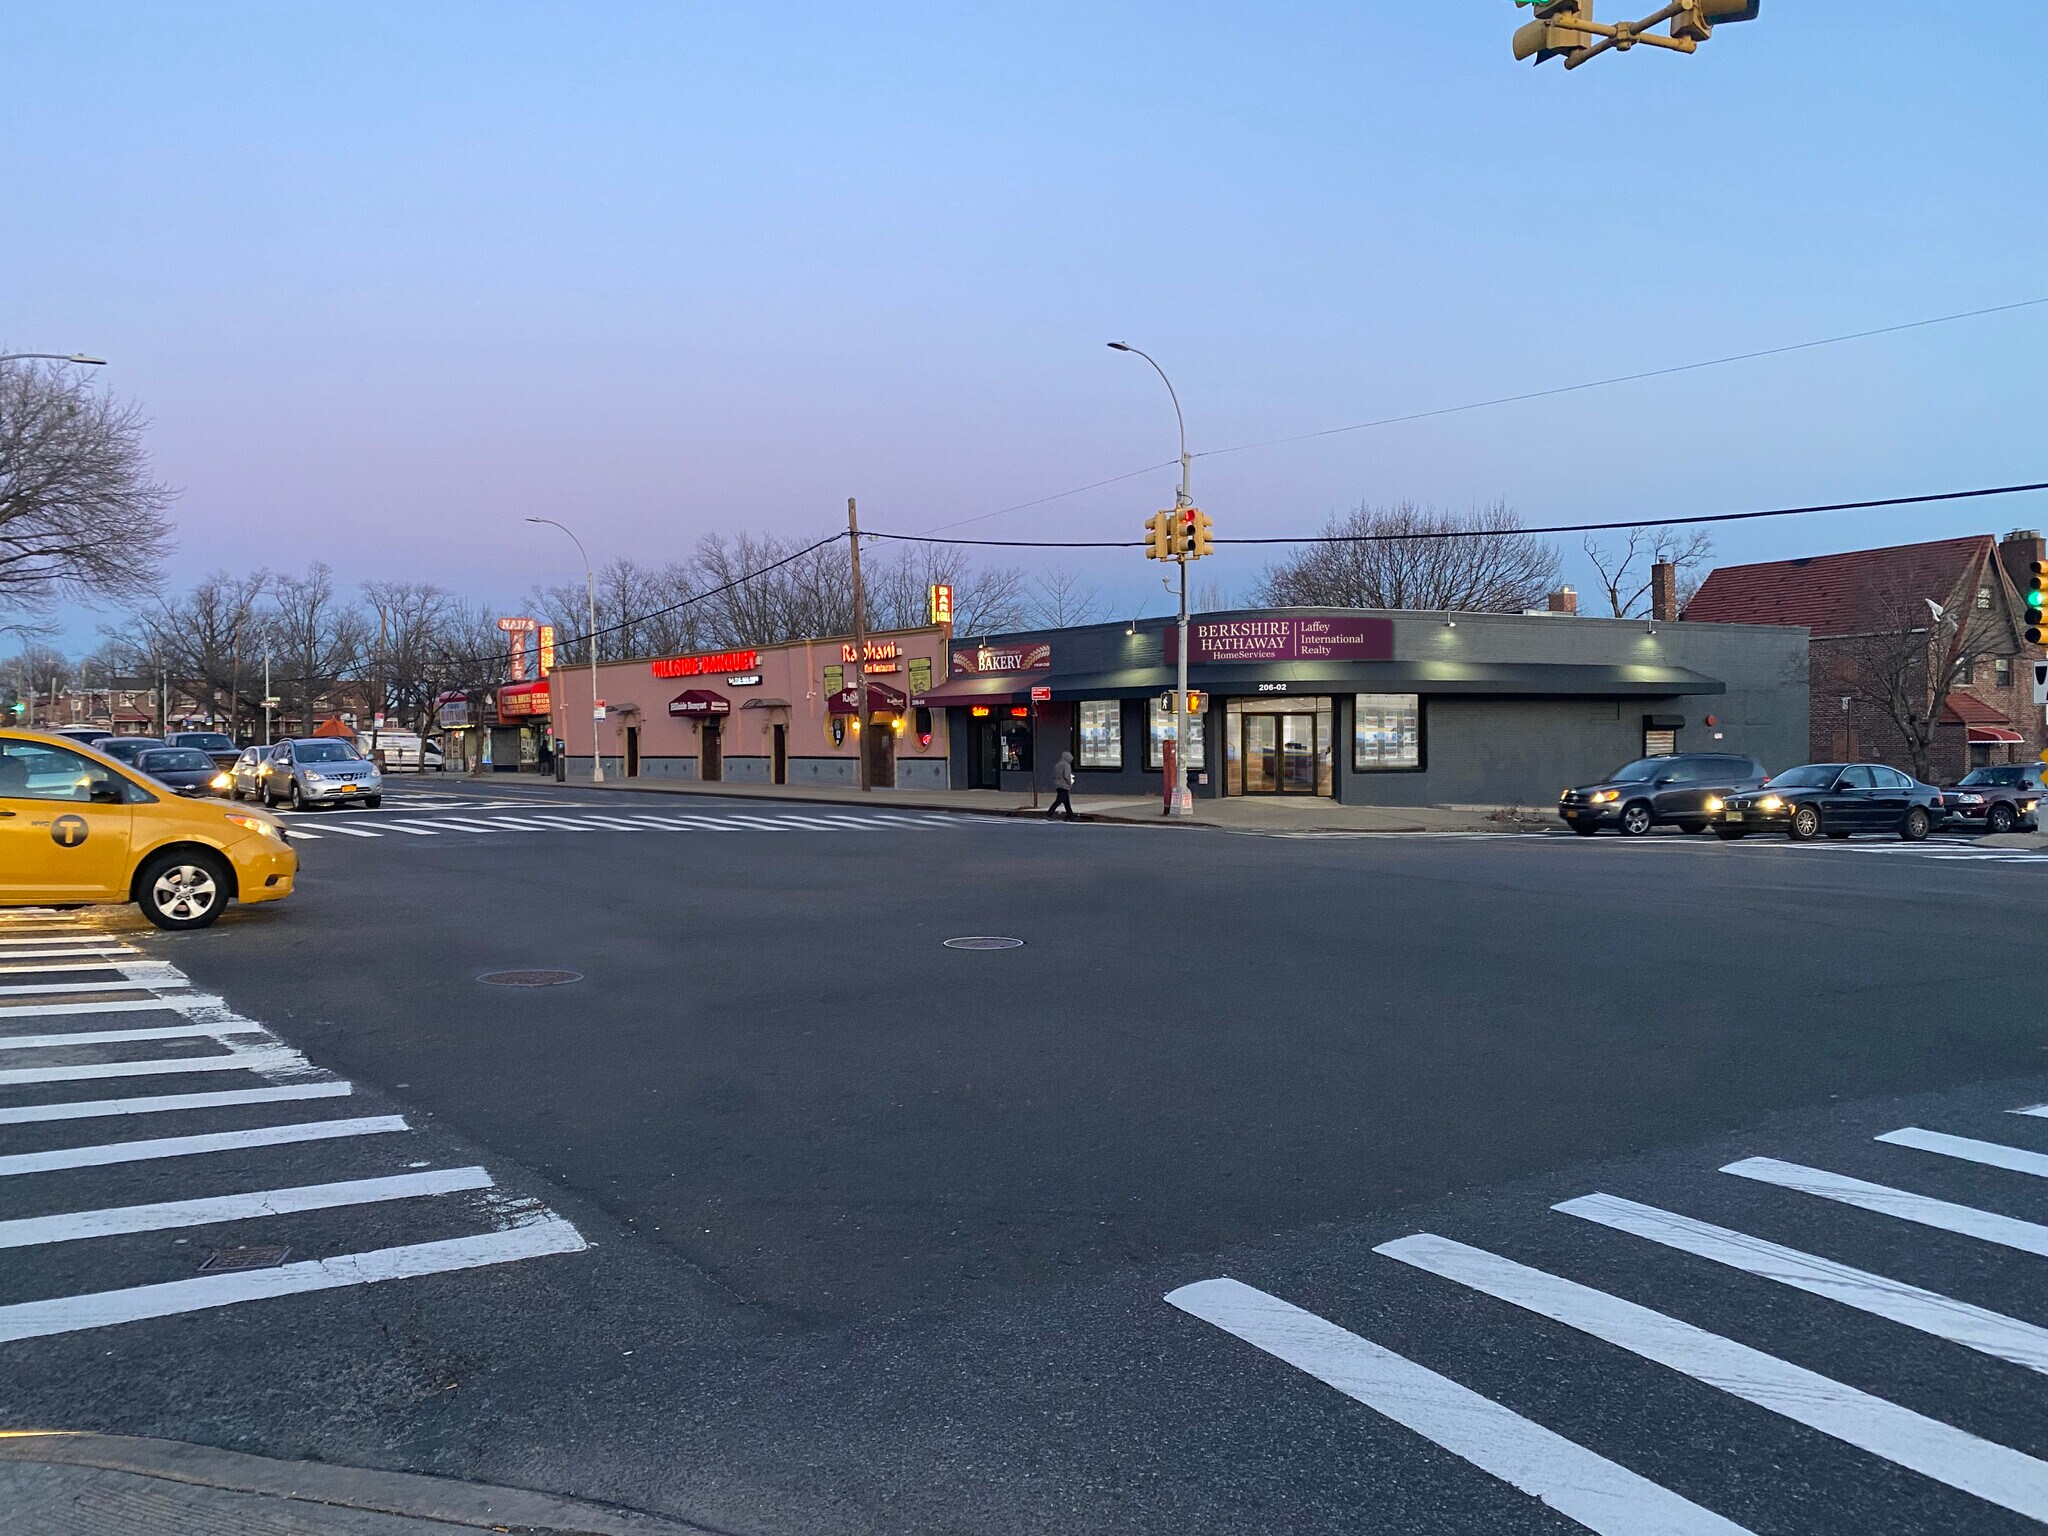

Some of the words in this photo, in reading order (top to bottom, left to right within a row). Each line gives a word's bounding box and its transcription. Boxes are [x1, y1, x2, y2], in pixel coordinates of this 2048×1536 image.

[938, 586, 949, 612] BAR
[501, 619, 535, 631] NAILS
[1198, 621, 1290, 638] BERKSHIRE
[1301, 621, 1330, 633] Laffey
[1201, 636, 1287, 651] HATHAWAY
[1301, 634, 1364, 644] International
[1213, 650, 1276, 660] HomeServices
[1301, 645, 1332, 656] Realty
[652, 657, 699, 678] HILLSIDE
[701, 650, 757, 675] BANQUET
[978, 654, 1023, 671] BAKERY
[1258, 683, 1287, 691] 206-02
